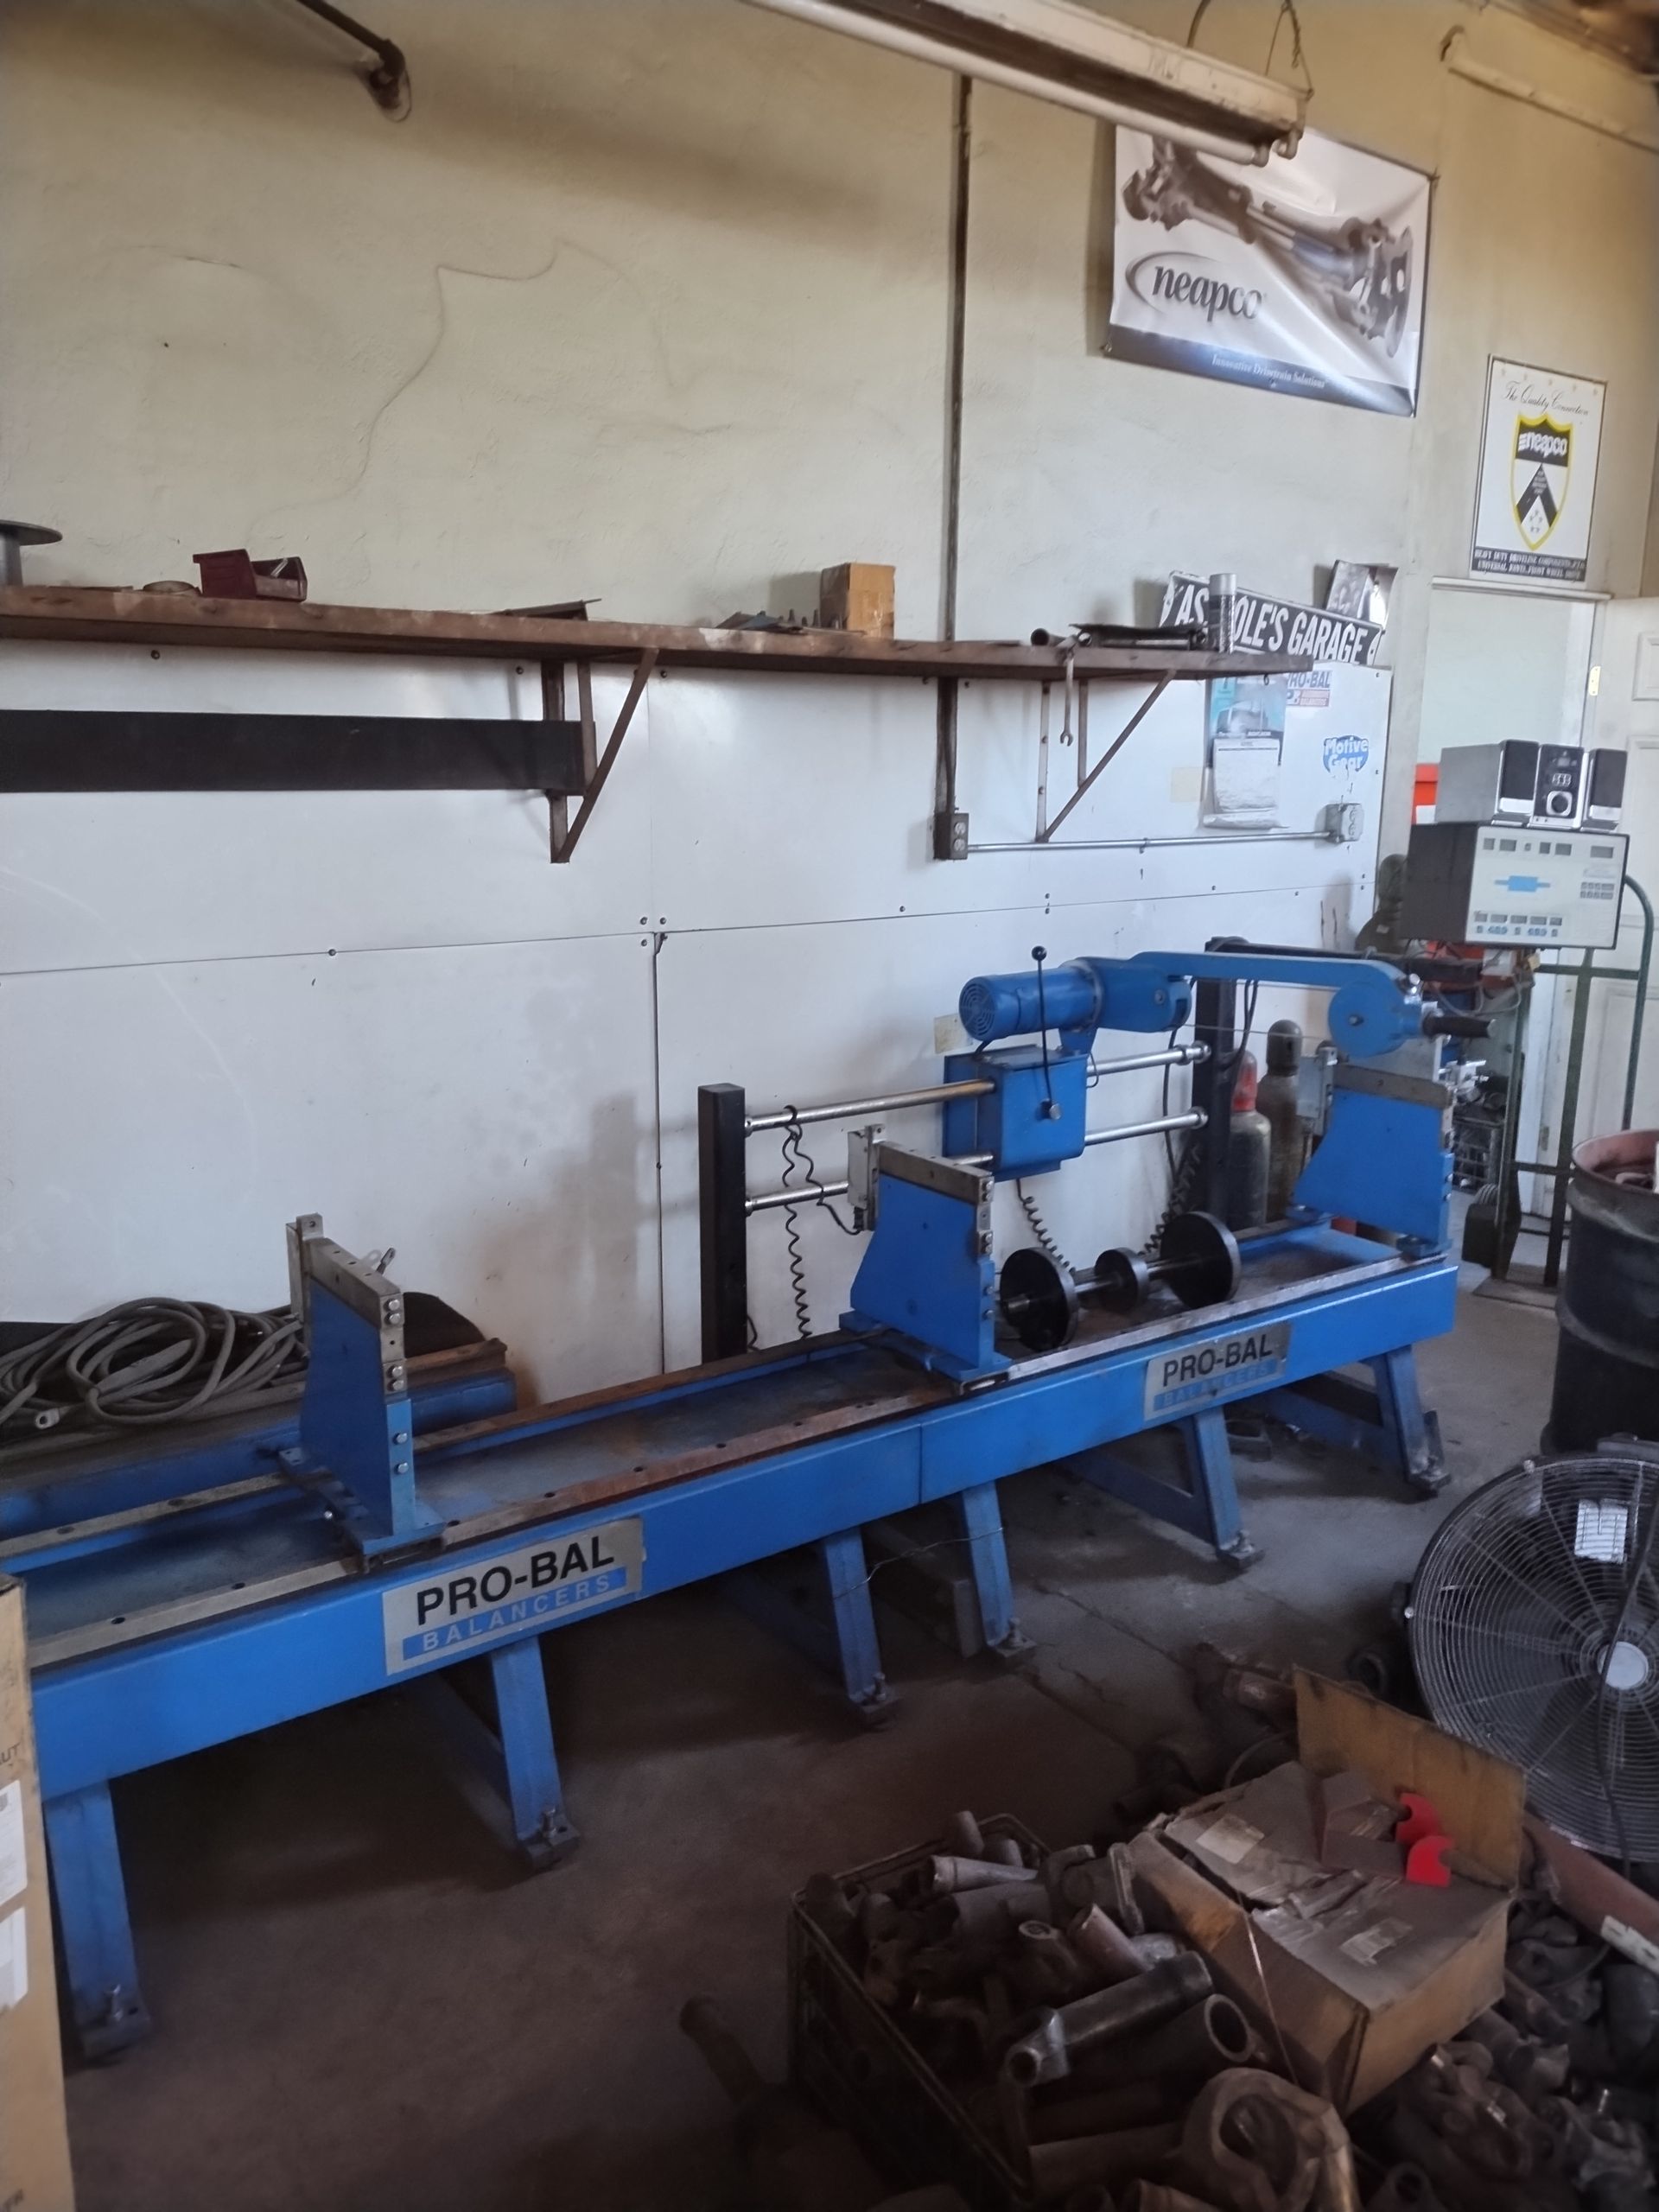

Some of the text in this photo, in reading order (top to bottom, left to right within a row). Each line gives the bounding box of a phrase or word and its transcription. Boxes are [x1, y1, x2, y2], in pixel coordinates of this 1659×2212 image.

[1152, 265, 1262, 323] neapco
[1504, 380, 1520, 402] The
[1524, 431, 1568, 458] neapco
[1220, 593, 1288, 652] OLE'S
[1287, 610, 1368, 664] GARAGE
[1287, 671, 1331, 688] RO-BAL
[1325, 737, 1369, 755] Motive
[1163, 1334, 1273, 1388] PRO-BAL
[416, 1535, 614, 1626] PRO-BAL
[423, 1573, 610, 1652] BALANCERS
